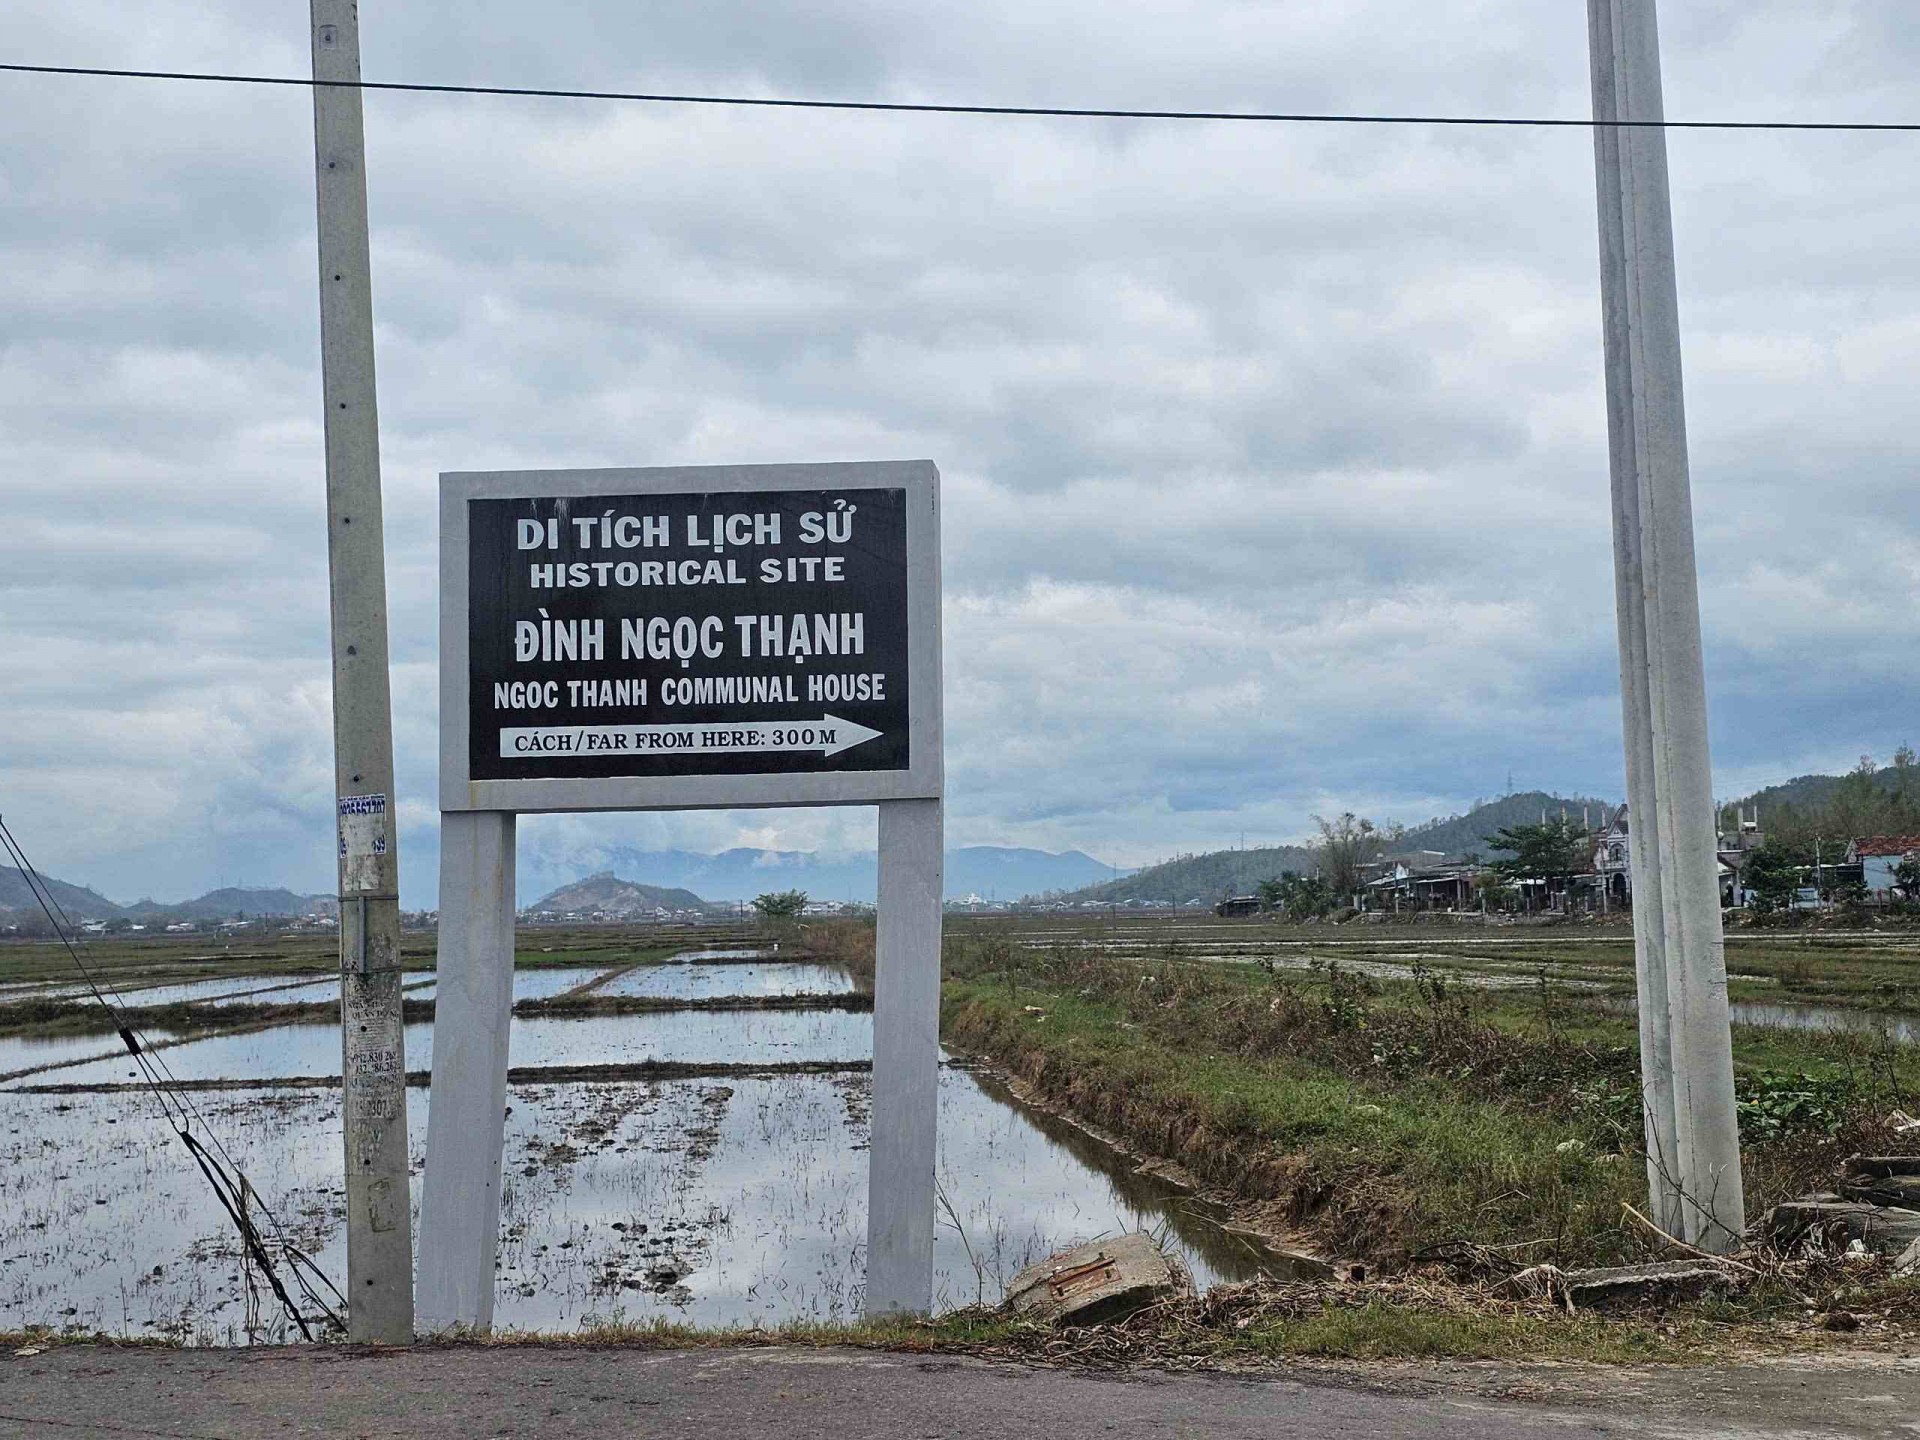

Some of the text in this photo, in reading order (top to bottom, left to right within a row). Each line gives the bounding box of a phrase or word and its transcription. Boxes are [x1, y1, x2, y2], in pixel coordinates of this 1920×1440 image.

[517, 498, 857, 553] DI TÍCH LỊCH SỬ
[530, 556, 845, 588] HISTORICAL SITE
[514, 607, 864, 668] ĐÌNH NGỌC THẠNH
[494, 673, 886, 709] NGOC THANH COMMUNAL HOUSE
[635, 732, 694, 749] FROM
[701, 730, 766, 747] HERE:
[772, 728, 815, 746] 300
[819, 729, 837, 745] M
